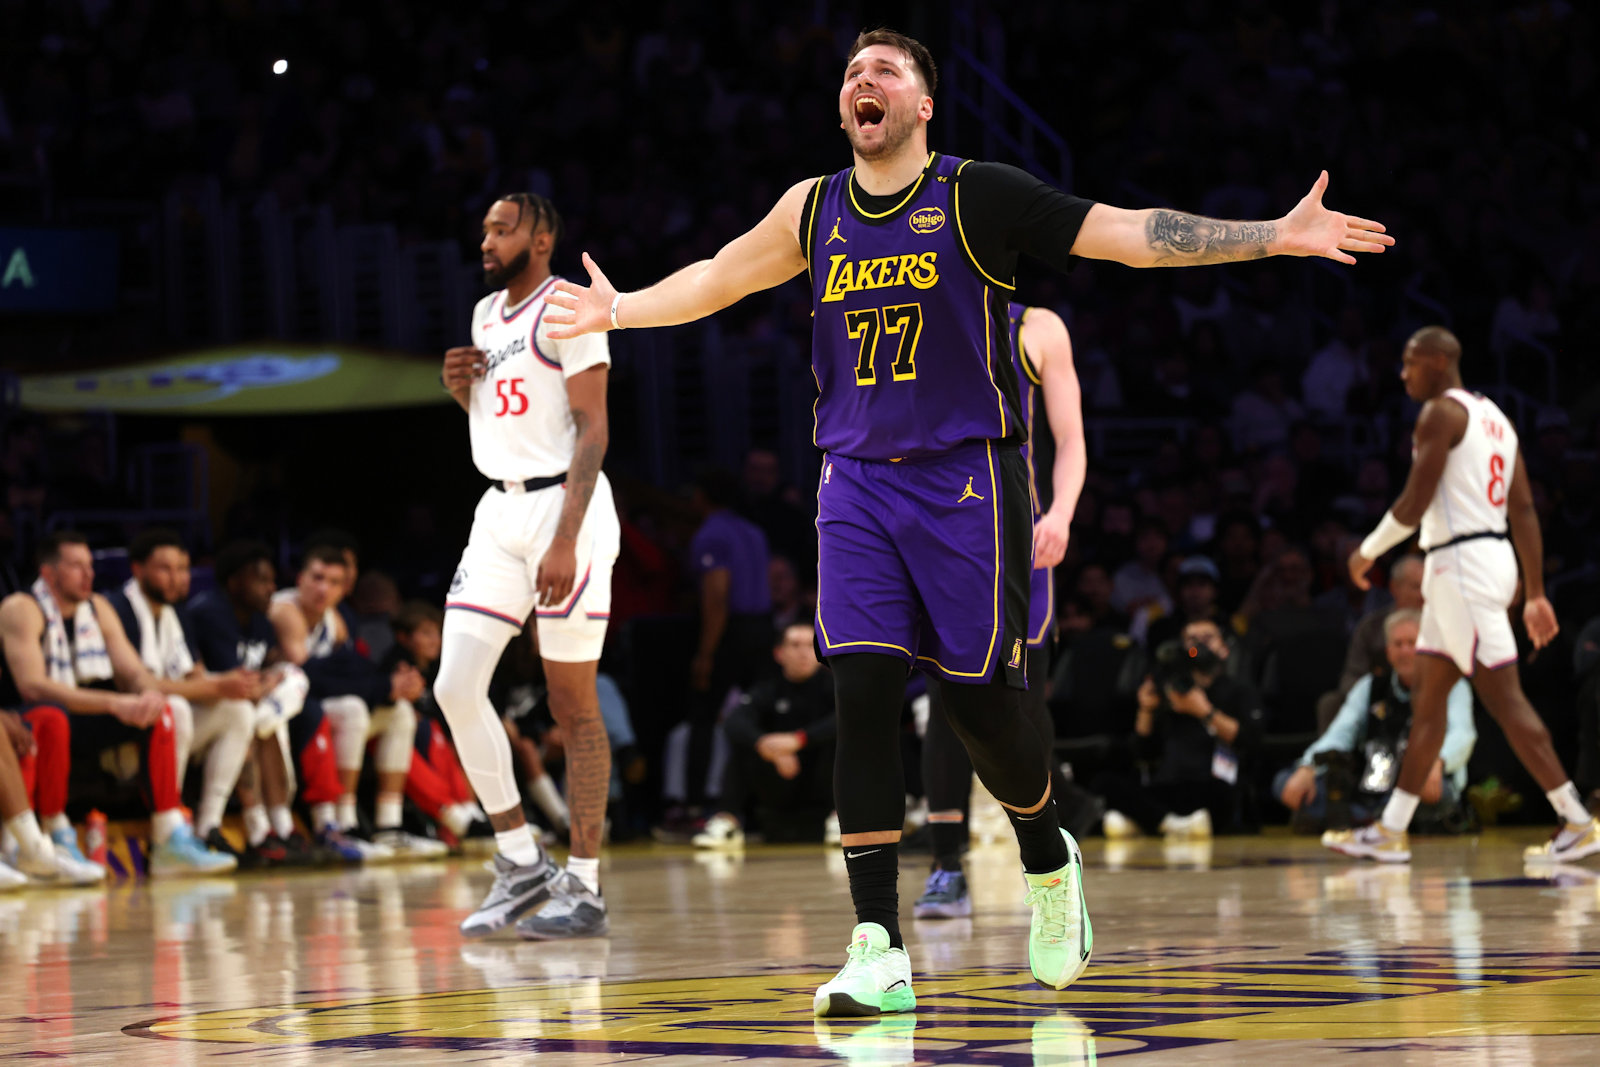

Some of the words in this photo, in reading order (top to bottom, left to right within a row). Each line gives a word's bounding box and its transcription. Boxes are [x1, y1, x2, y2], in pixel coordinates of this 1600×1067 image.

[912, 214, 943, 226] bibigo
[0, 246, 35, 290] A
[821, 251, 939, 302] LAKERS
[844, 302, 923, 386] 77
[495, 378, 528, 417] 55
[1488, 454, 1505, 507] 8
